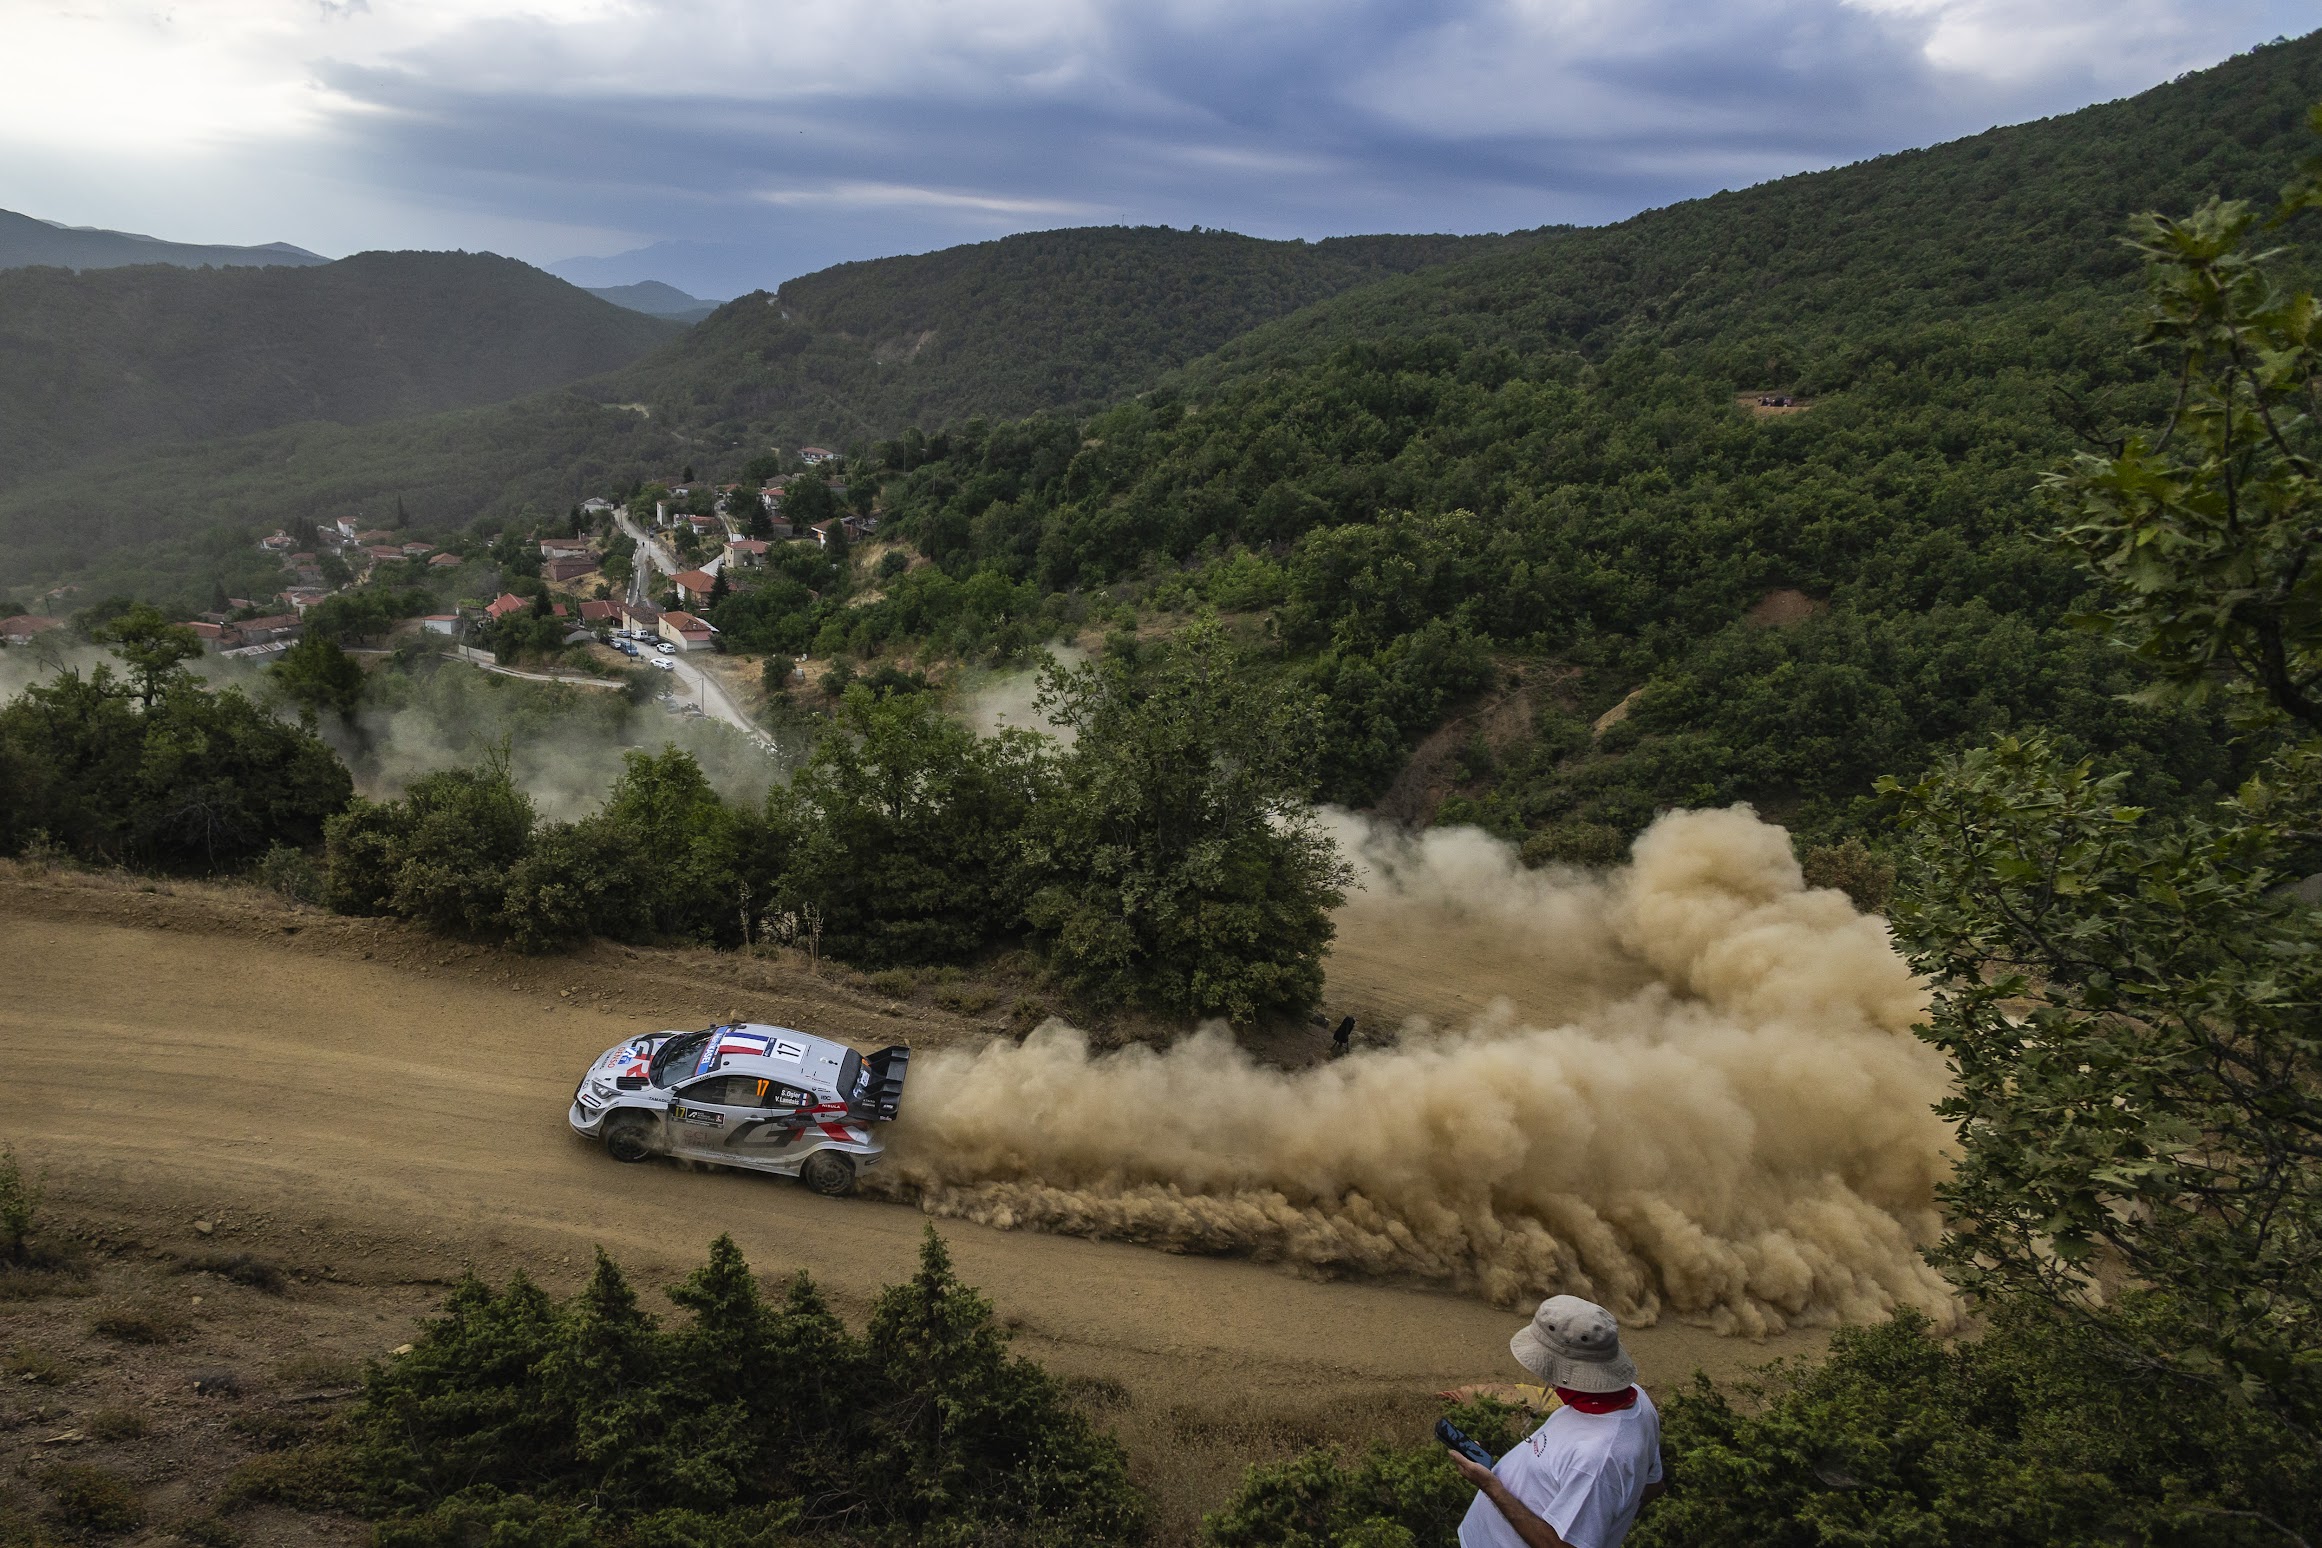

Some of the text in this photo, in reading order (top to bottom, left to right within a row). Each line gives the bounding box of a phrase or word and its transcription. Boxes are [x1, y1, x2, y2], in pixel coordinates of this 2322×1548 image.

[607, 1046, 627, 1068] DENSO
[777, 1043, 801, 1057] 17
[756, 1079, 770, 1097] 17
[781, 1089, 801, 1099] S.Ogier
[675, 1107, 686, 1118] 17
